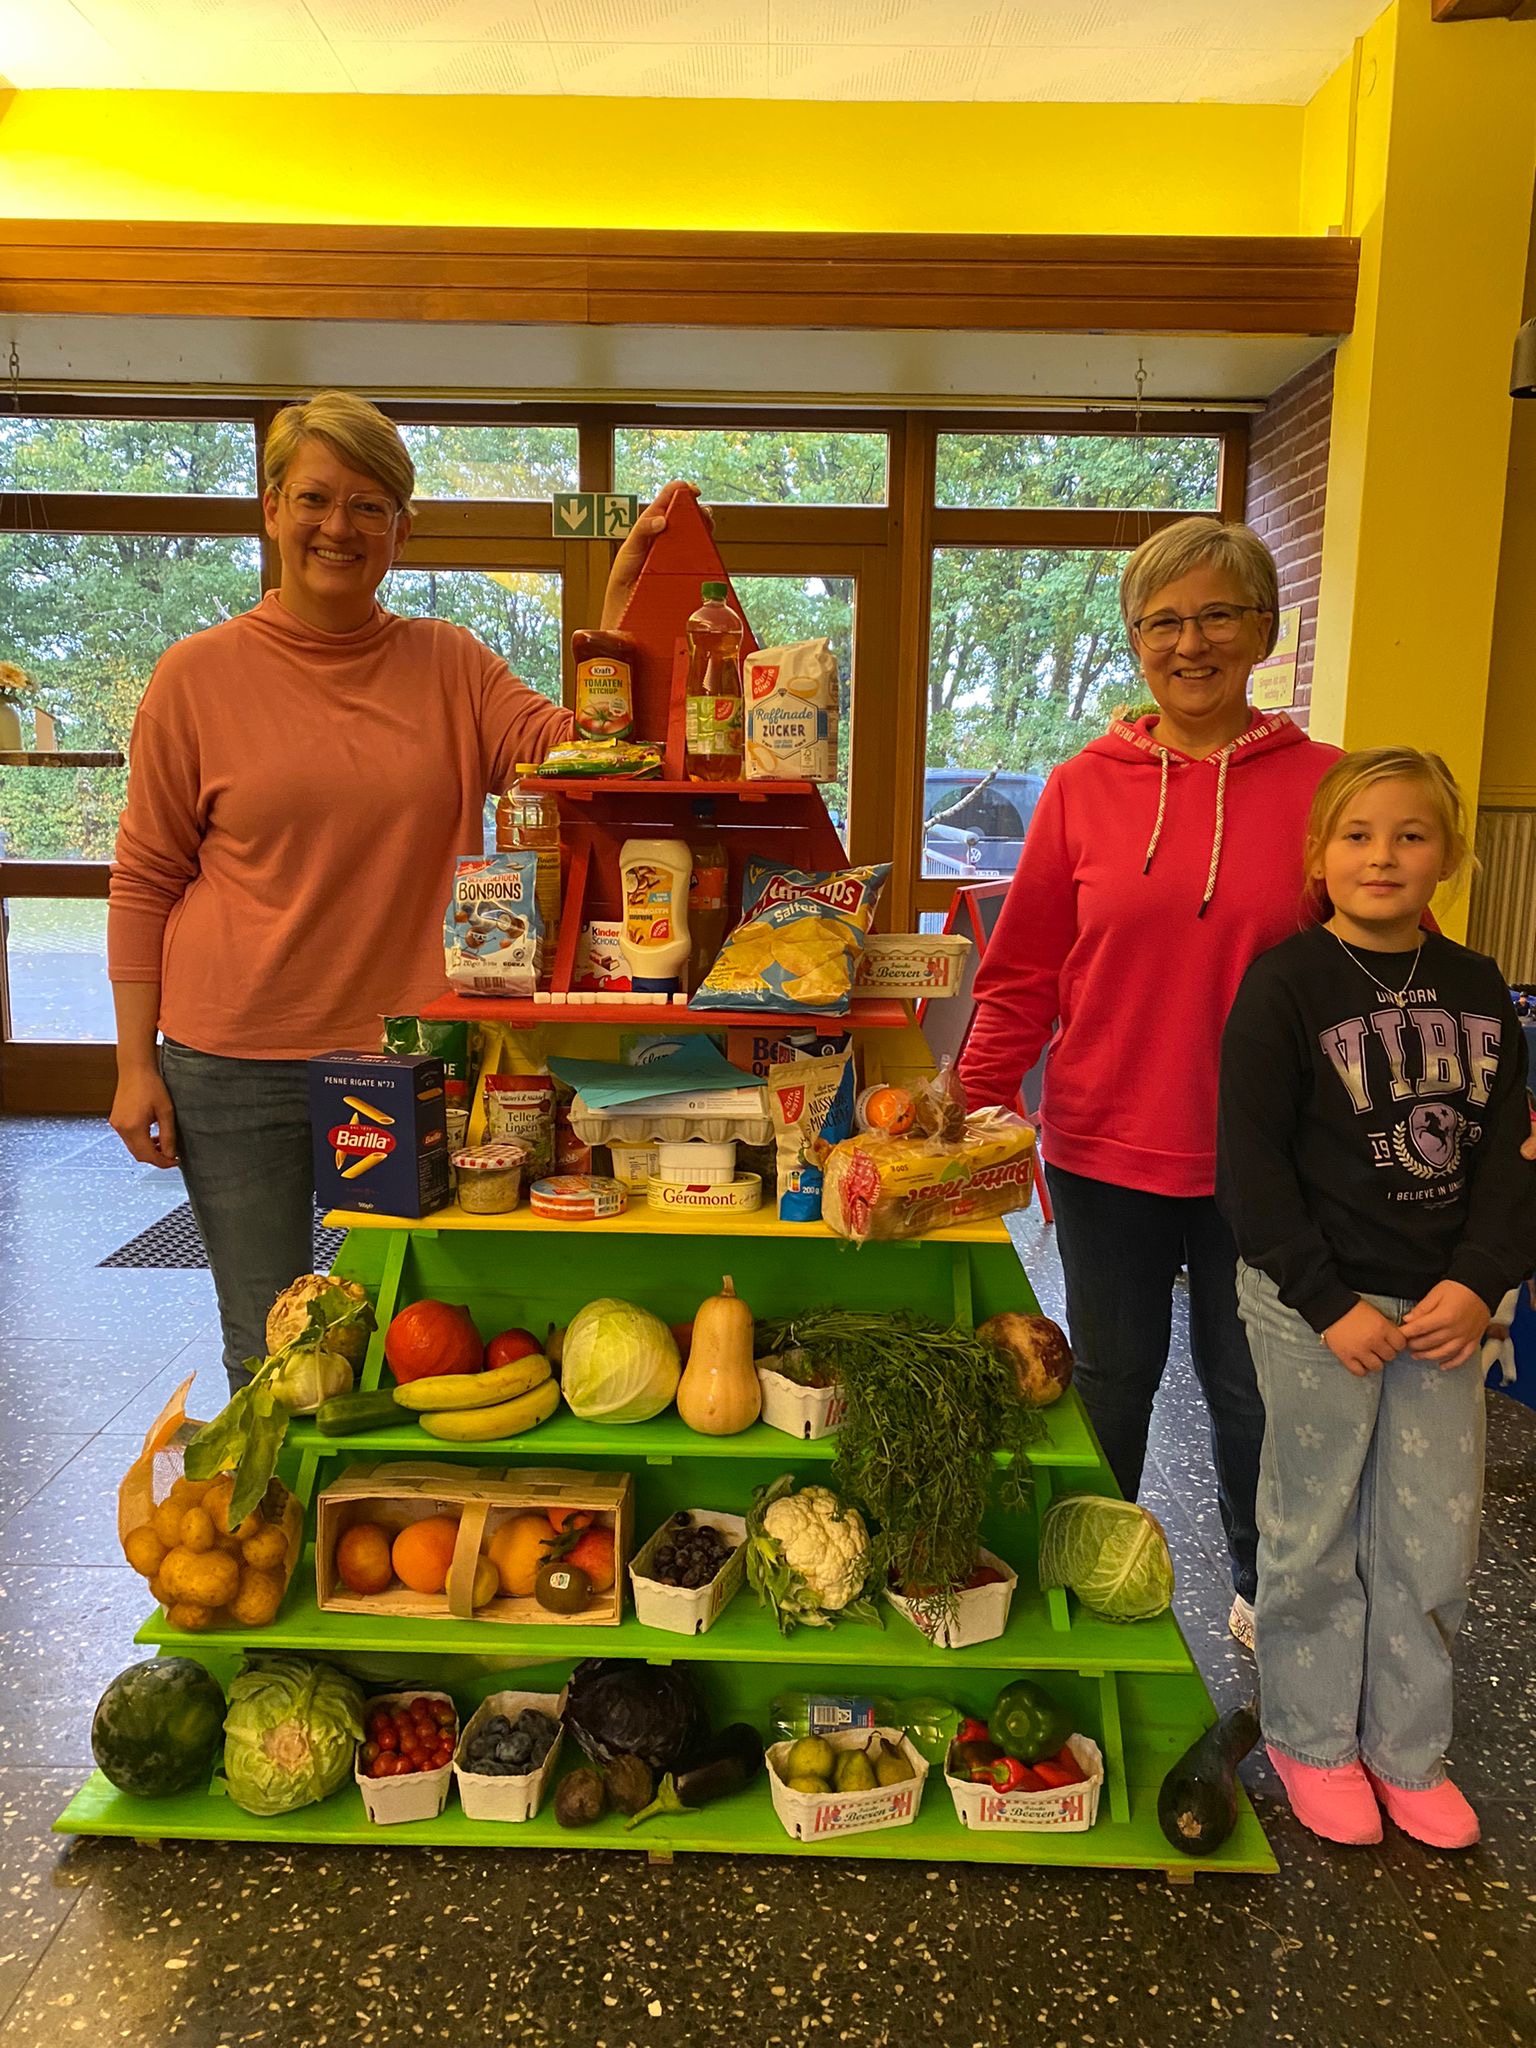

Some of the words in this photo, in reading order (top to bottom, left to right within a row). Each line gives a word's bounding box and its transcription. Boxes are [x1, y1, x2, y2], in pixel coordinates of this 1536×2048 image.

[584, 679, 623, 687] TOMATEN
[755, 707, 813, 724] Raffinade
[763, 725, 805, 737] ZUCKER
[459, 882, 521, 901] BONBONS
[773, 904, 817, 922] Salted
[592, 926, 619, 938] Kinder
[592, 936, 620, 946] SCHOKO
[876, 966, 920, 978] Beeren
[1376, 988, 1437, 1004] UNCORN
[324, 1076, 348, 1085] PENNE
[350, 1078, 375, 1087] RIGATE
[507, 1112, 537, 1122] Teller
[505, 1122, 538, 1134] Linsen
[336, 1130, 387, 1149] Barilla
[1371, 1140, 1391, 1159] 19
[802, 1186, 814, 1194] 200
[1396, 1189, 1435, 1201] BELIEVE
[1437, 1186, 1447, 1196] IN
[663, 1188, 737, 1206] Géramont
[843, 1809, 886, 1823] Beeren
[1010, 1807, 1055, 1818] Beeren
